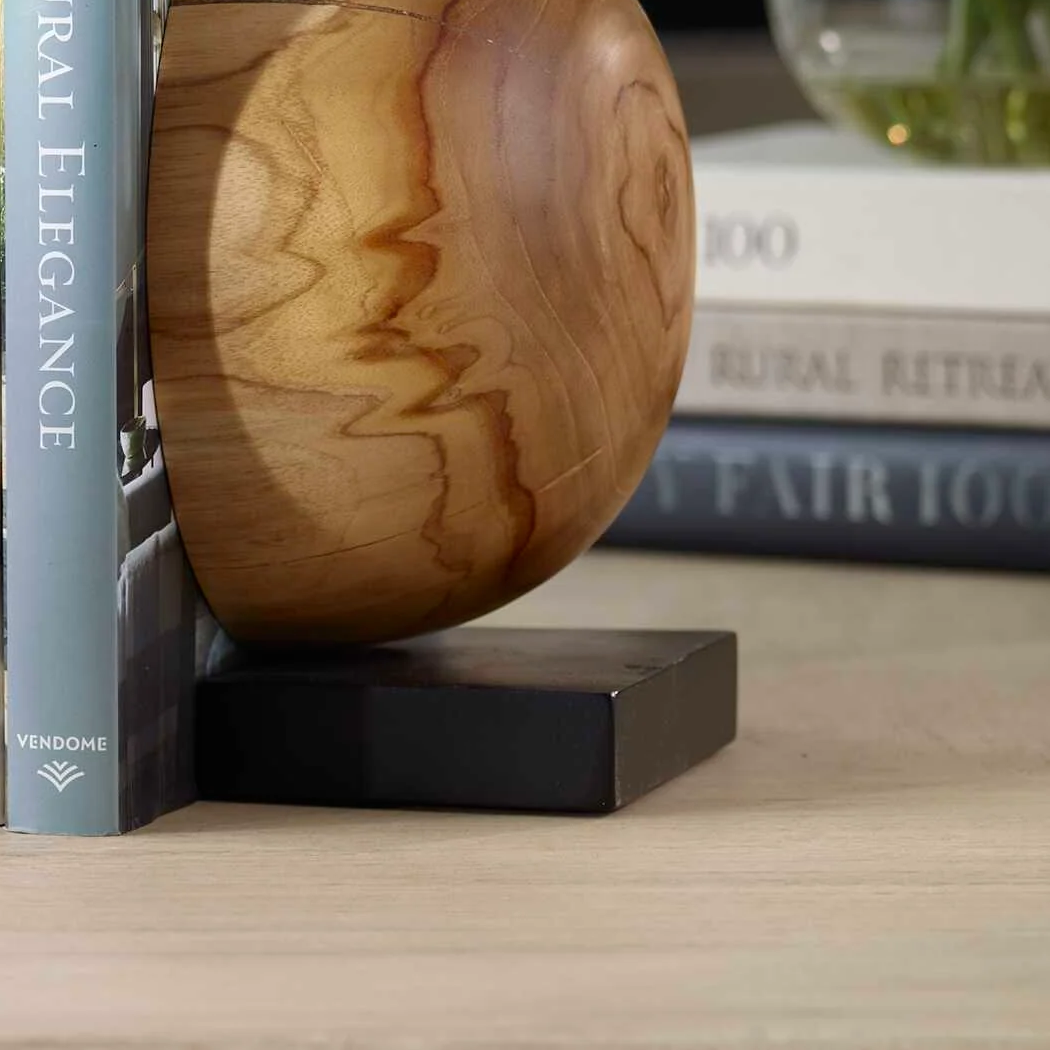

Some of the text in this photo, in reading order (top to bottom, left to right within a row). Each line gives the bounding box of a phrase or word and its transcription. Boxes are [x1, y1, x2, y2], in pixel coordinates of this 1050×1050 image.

[37, 140, 87, 450] ELEGANCE
[709, 342, 859, 397] RURAL
[713, 451, 894, 527] FAIR
[16, 733, 108, 752] VENDOME
